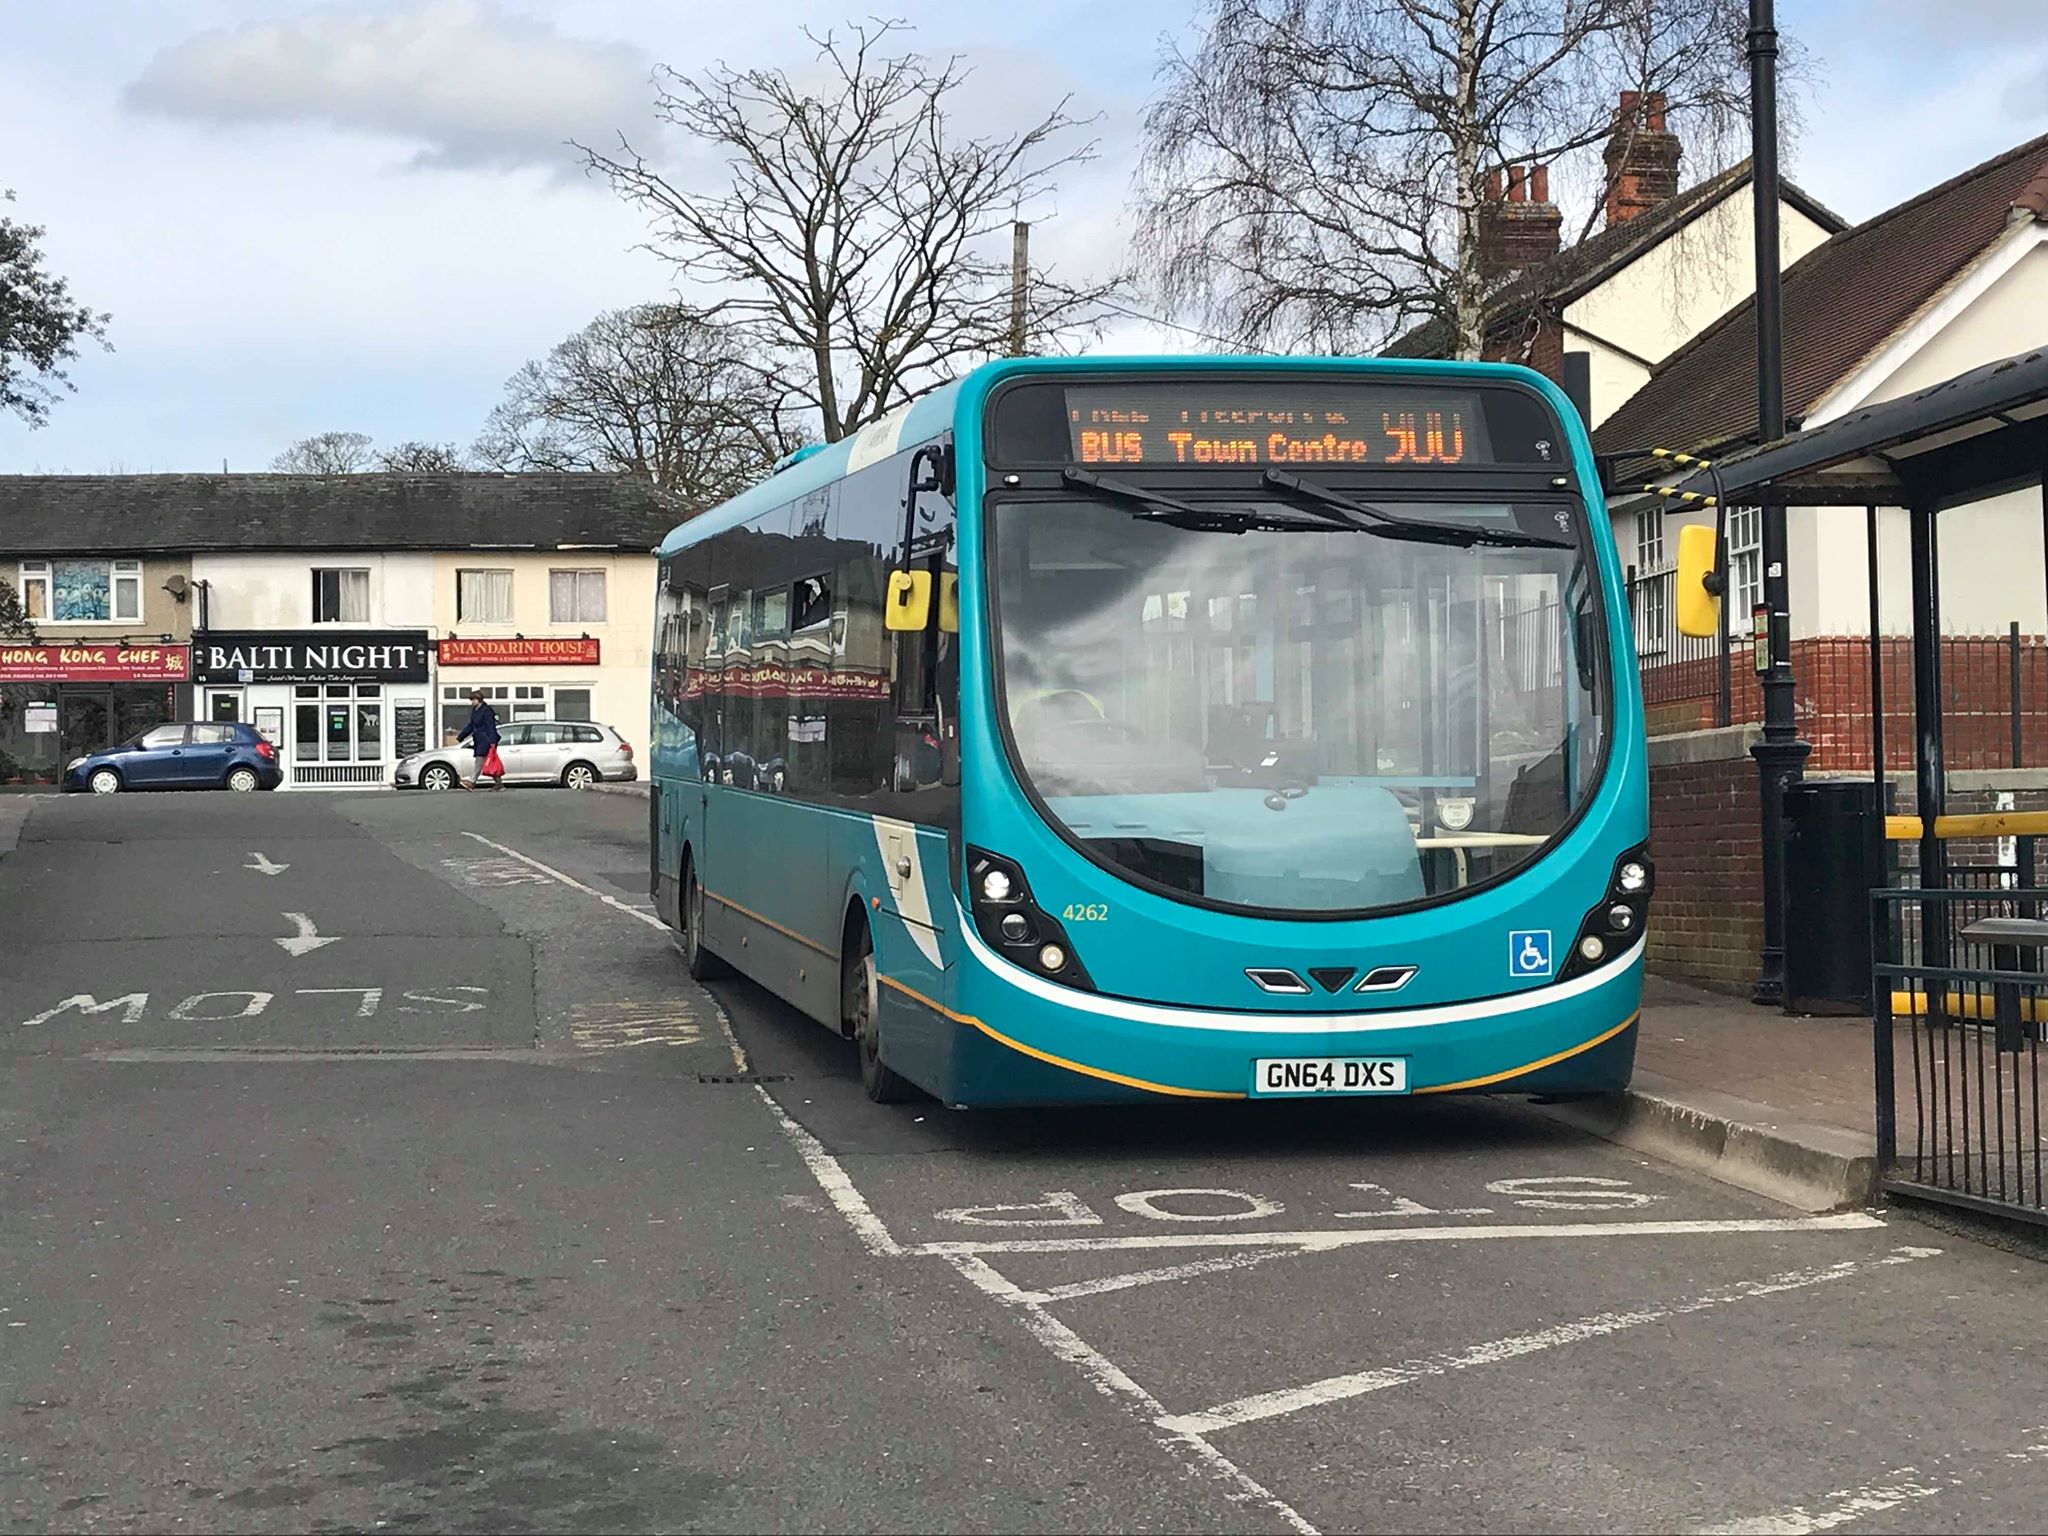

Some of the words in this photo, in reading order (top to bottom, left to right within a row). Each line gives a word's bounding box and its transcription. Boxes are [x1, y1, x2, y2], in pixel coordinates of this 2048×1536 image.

[1081, 431, 1142, 462] BUS
[1168, 431, 1257, 463] Town
[1267, 432, 1367, 463] Centre
[1, 650, 48, 664] HONG
[60, 648, 106, 664] KONG
[117, 650, 160, 663] CHEF
[209, 646, 295, 669] BALTI
[304, 645, 413, 669] NIGHT
[452, 642, 534, 654] MANDARIN
[540, 641, 586, 654] HOUSE
[1063, 904, 1108, 921] 4262
[22, 986, 489, 1026] SLOW
[1267, 1063, 1335, 1088] GN64
[1344, 1062, 1395, 1087] DXS
